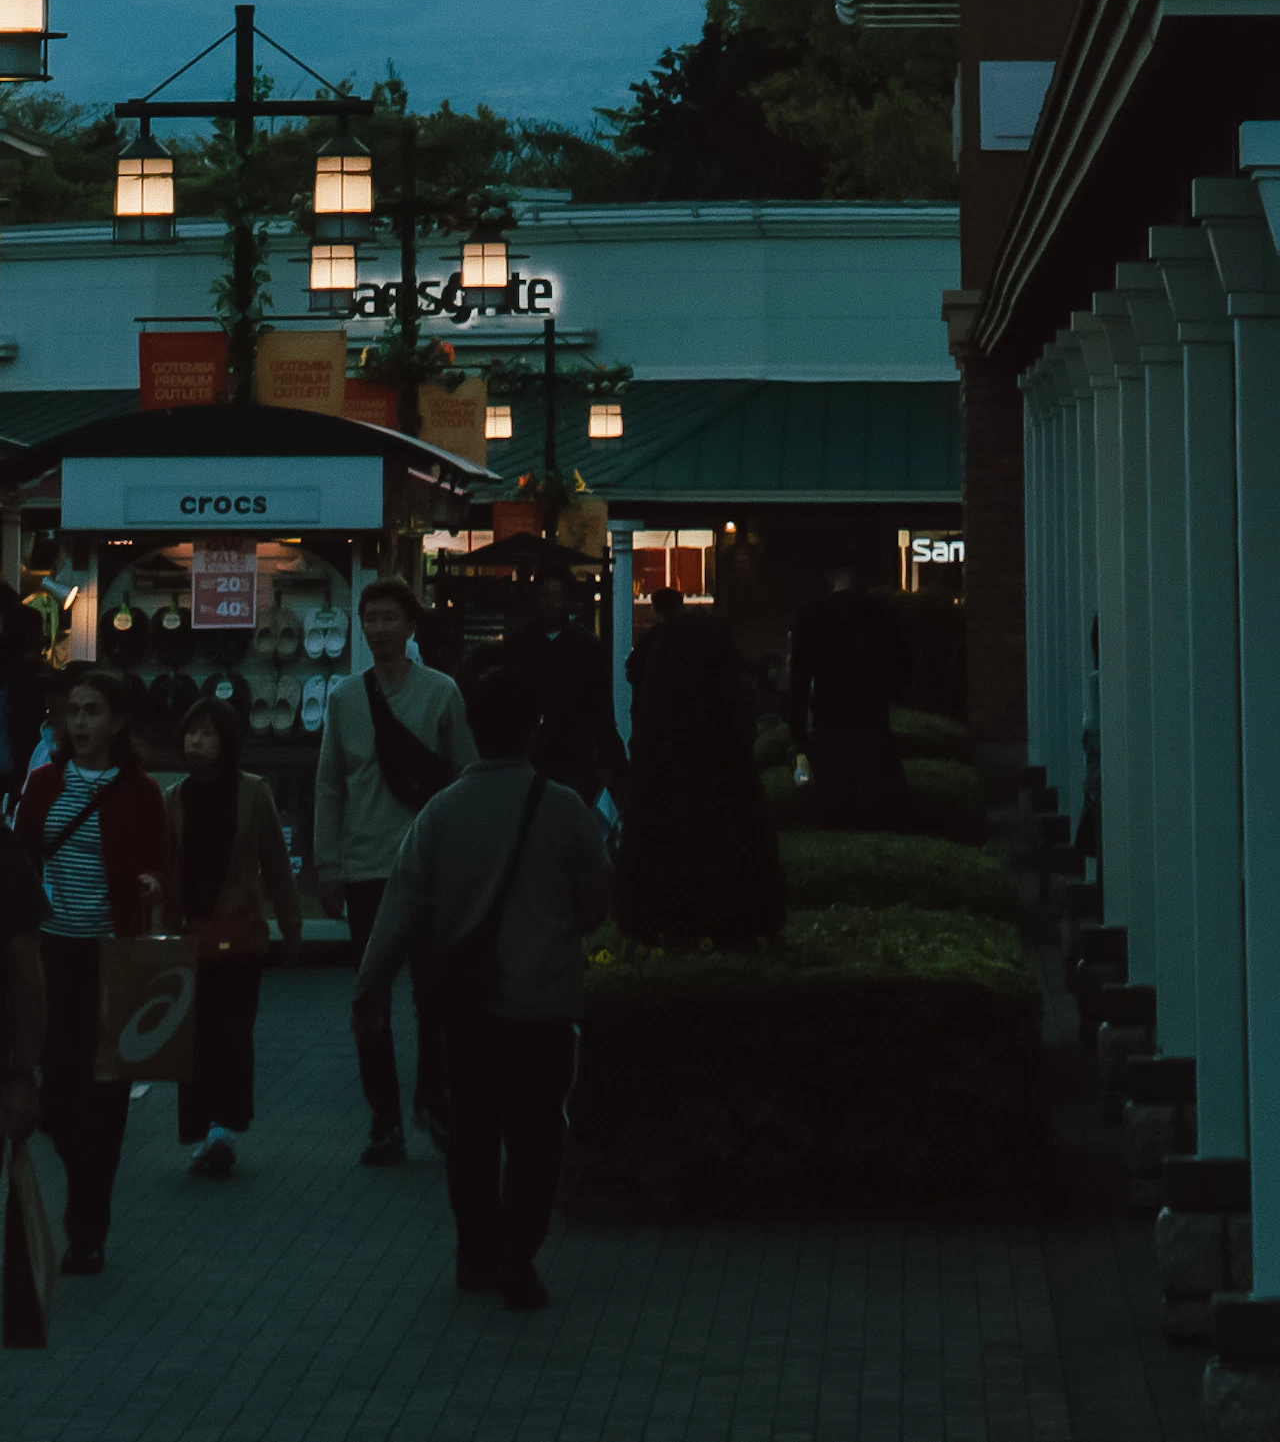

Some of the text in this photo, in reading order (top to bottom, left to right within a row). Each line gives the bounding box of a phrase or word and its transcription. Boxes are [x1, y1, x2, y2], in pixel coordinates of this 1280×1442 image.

[152, 361, 216, 373] GOTEMBA
[269, 360, 333, 372] GOTEMBA
[154, 375, 212, 386] PREMIUM
[271, 373, 331, 385] PREMIUM
[154, 388, 212, 400] OUTLETS
[272, 386, 330, 398] OUTLETS
[180, 496, 267, 514] crocs
